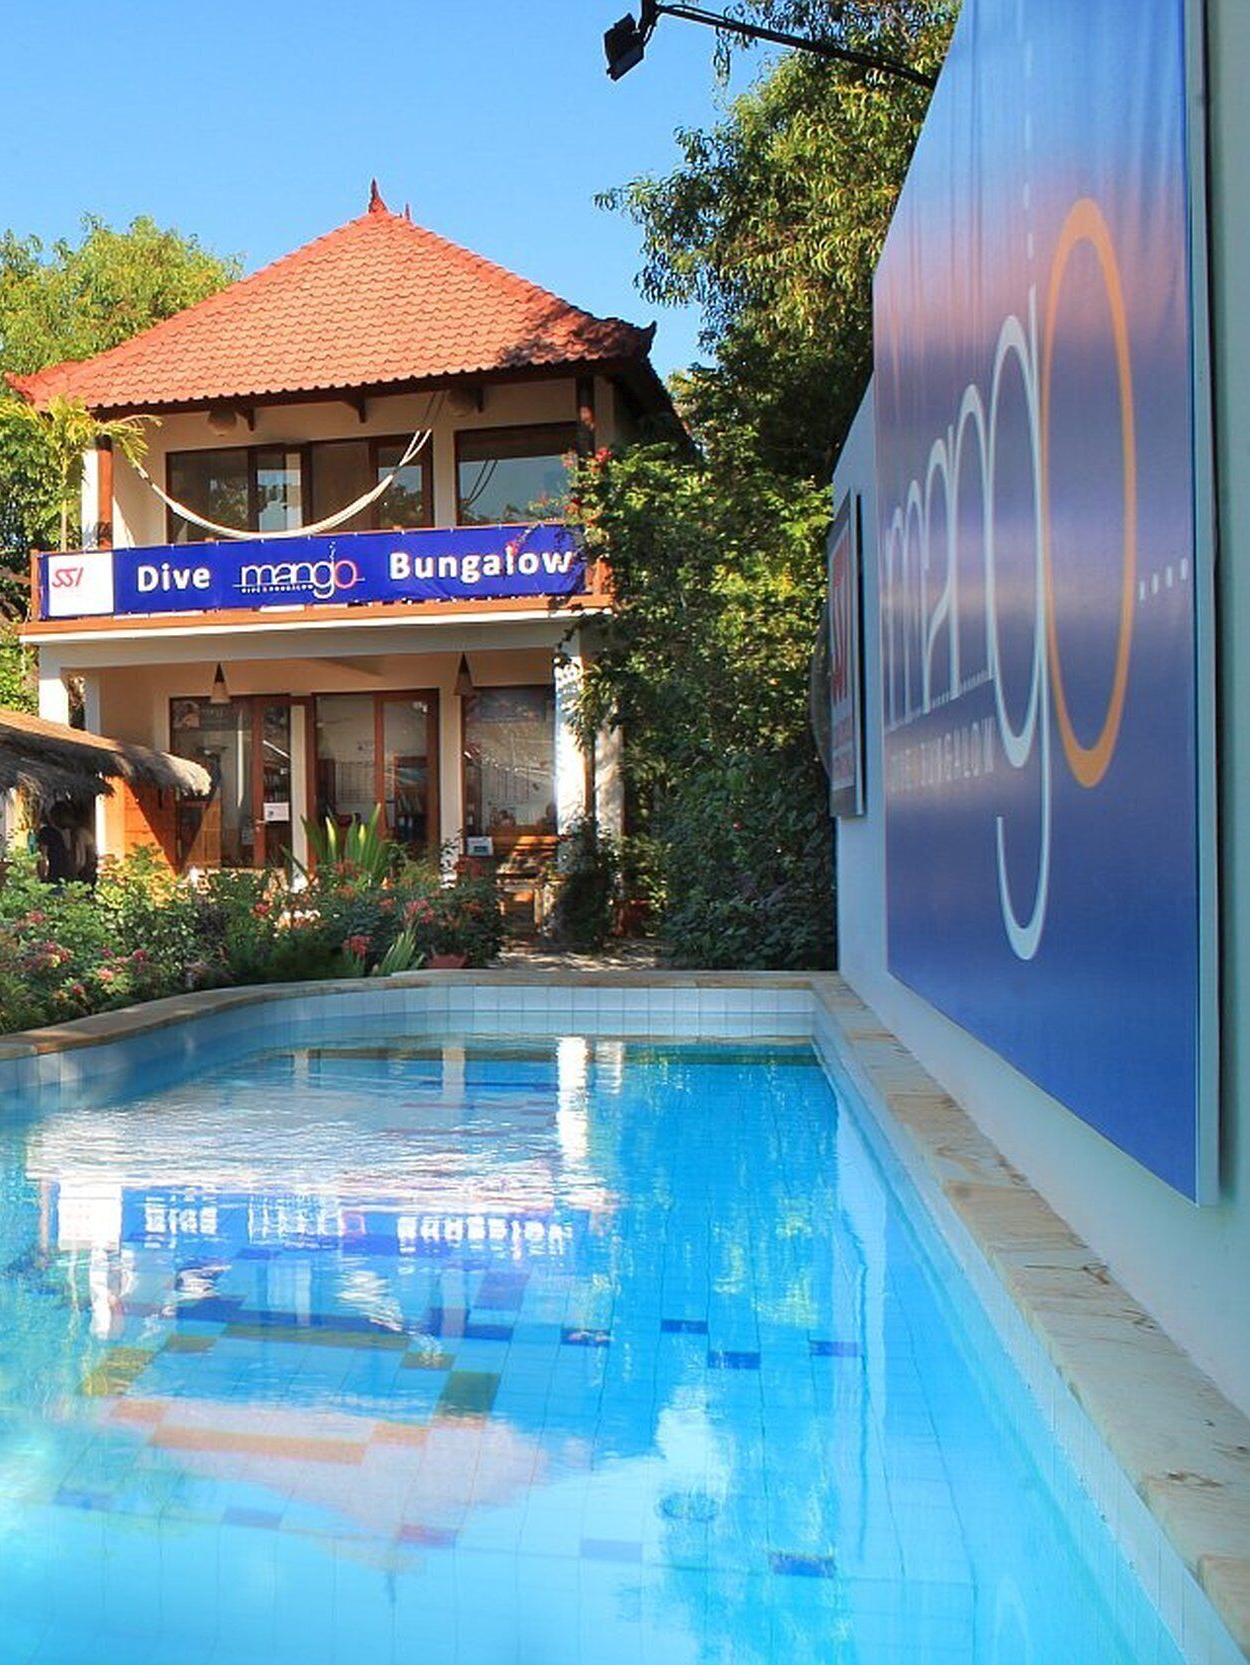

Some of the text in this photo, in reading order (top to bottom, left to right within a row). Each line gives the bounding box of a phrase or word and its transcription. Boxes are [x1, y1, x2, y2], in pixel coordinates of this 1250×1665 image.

[52, 567, 84, 588] SSI
[137, 545, 573, 599] Dive mango Bungalow
[883, 196, 1137, 961] mango
